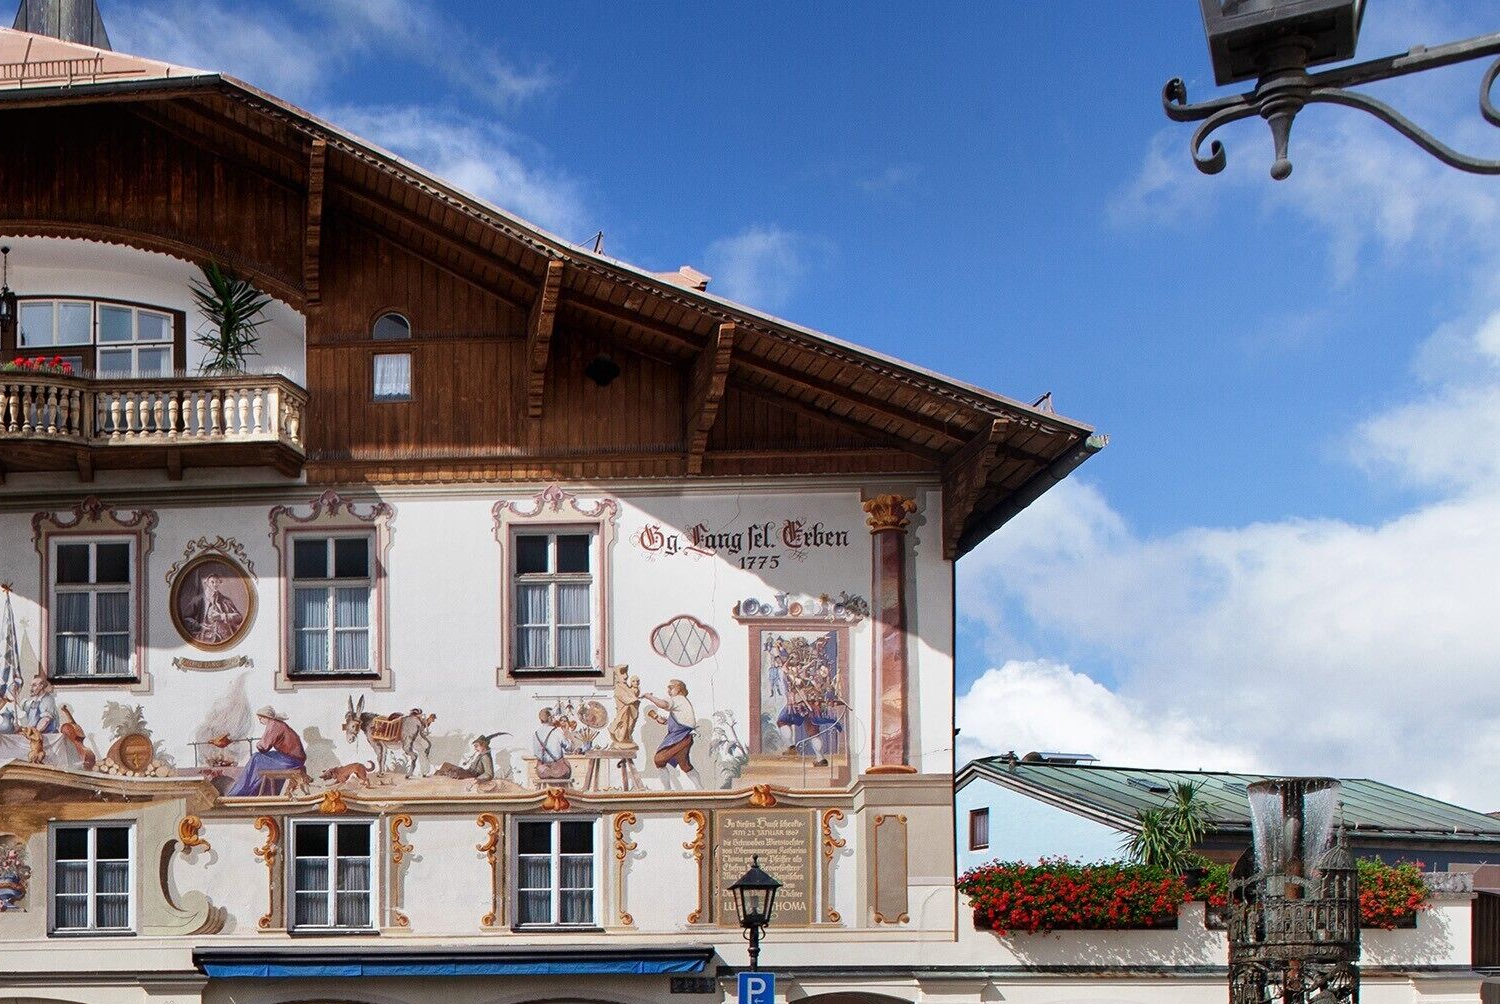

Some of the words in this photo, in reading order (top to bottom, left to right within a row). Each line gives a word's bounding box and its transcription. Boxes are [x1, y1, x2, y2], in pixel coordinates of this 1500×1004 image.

[639, 523, 682, 555] Gg.
[685, 522, 743, 557] Lang
[780, 518, 850, 549] Erben
[739, 555, 780, 570] 1775
[747, 977, 767, 1004] P
